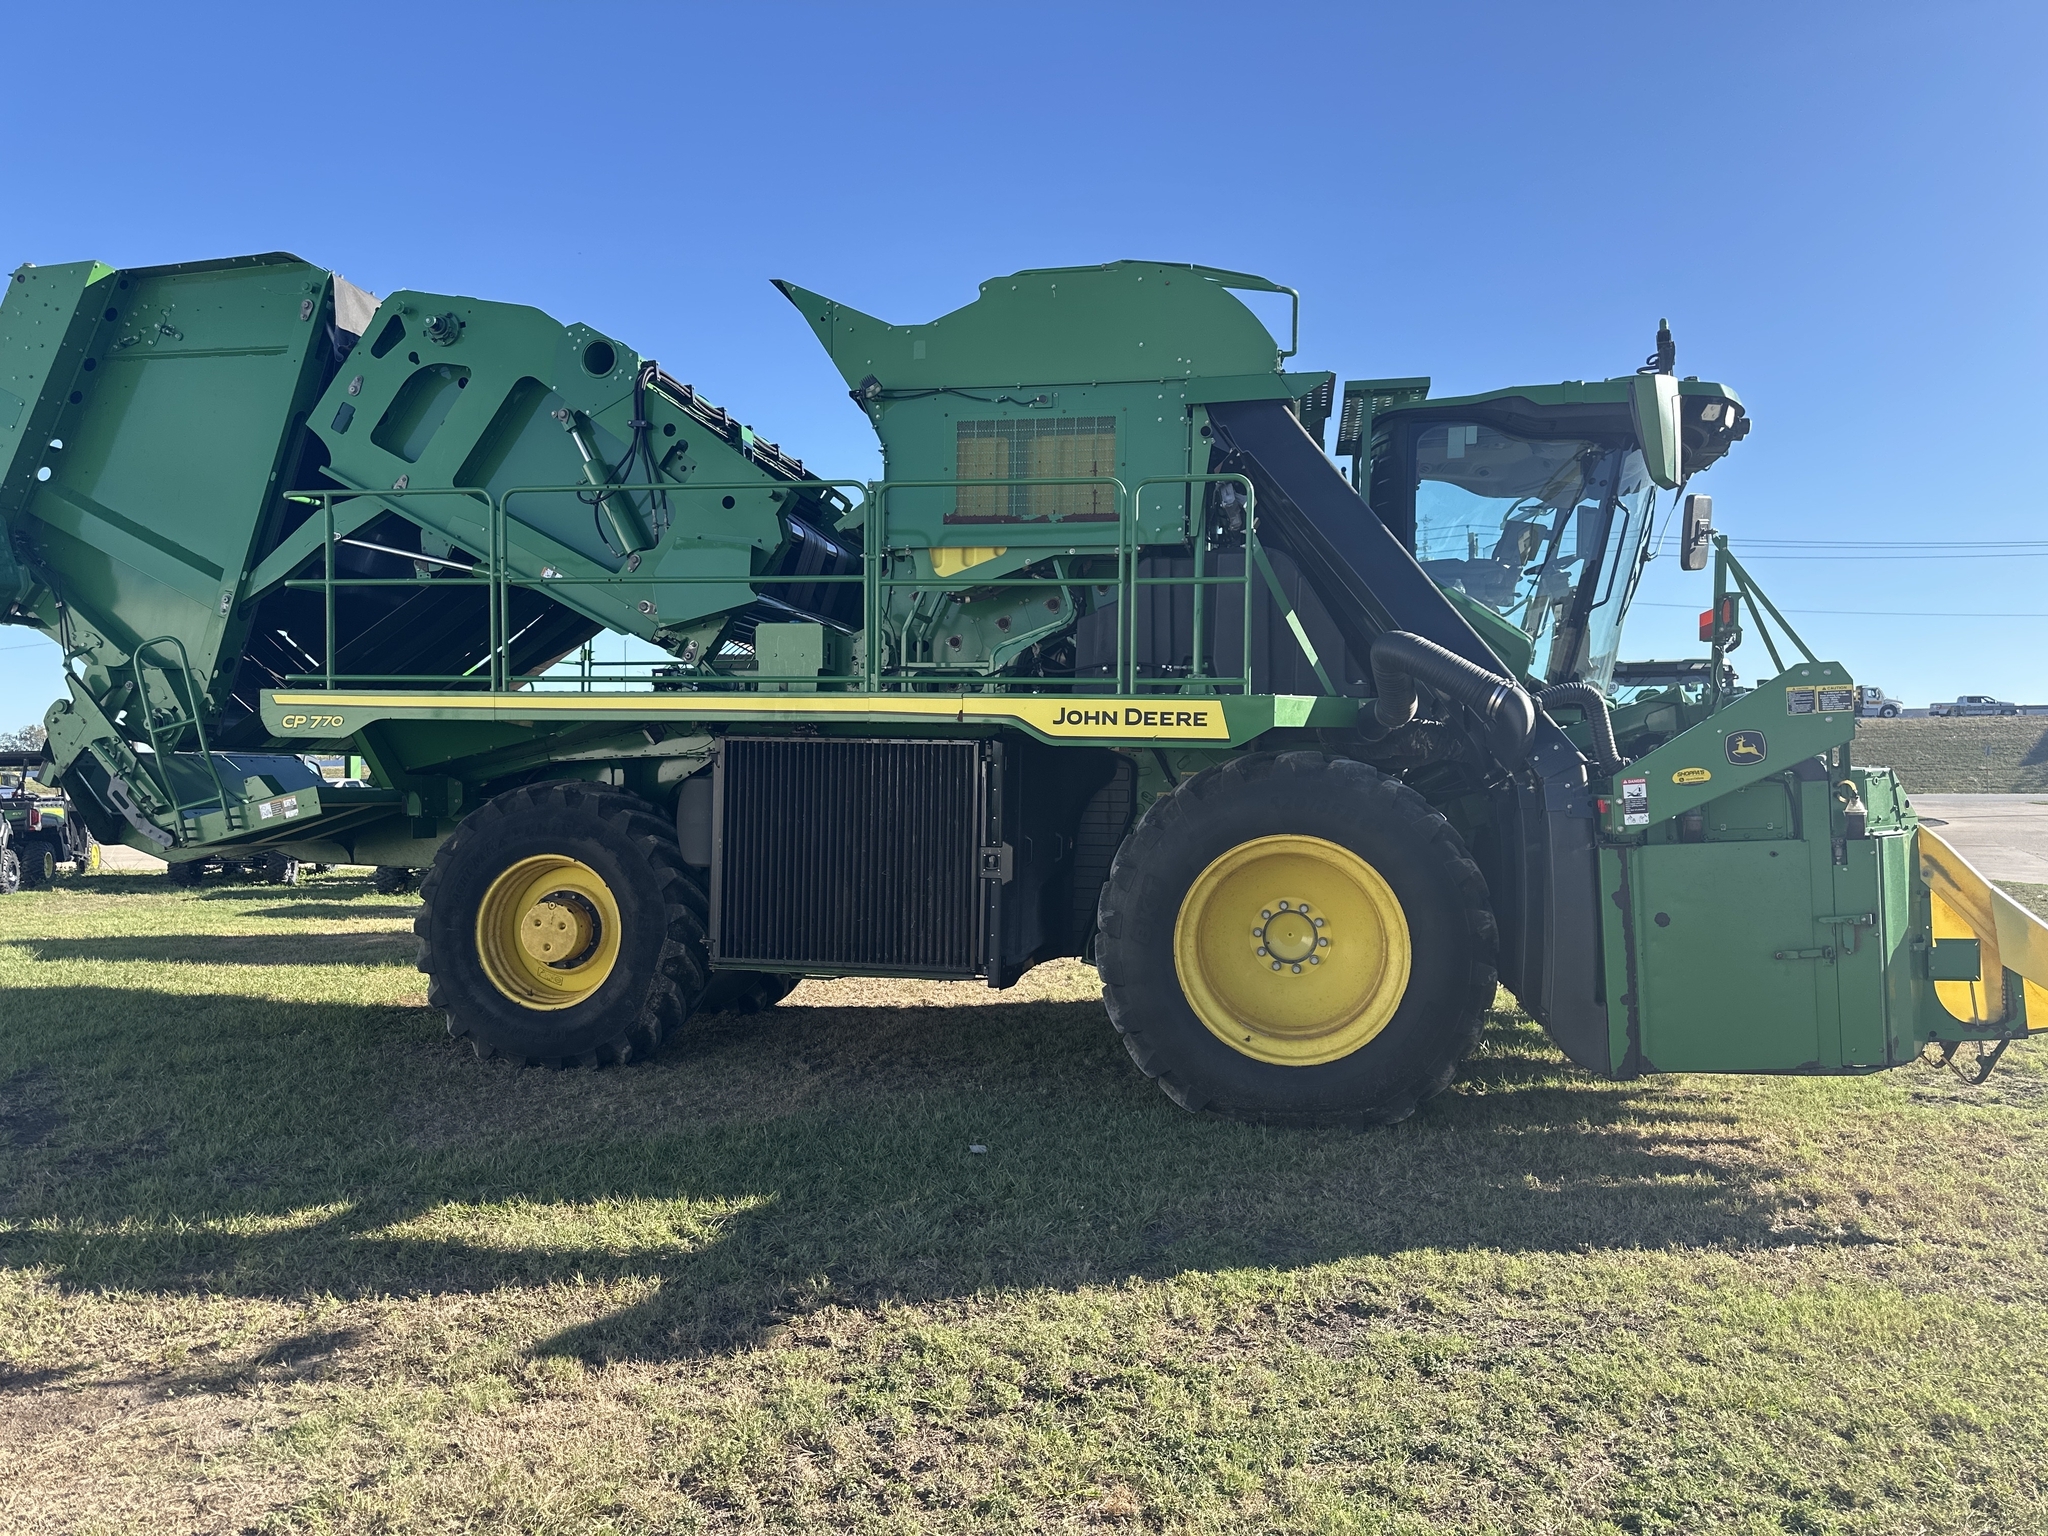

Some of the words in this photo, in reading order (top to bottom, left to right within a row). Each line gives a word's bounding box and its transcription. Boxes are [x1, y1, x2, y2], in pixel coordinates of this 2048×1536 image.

[282, 714, 307, 729] CP
[309, 715, 344, 729] 770
[1052, 707, 1118, 726] JOHN
[1124, 708, 1208, 727] DEERE
